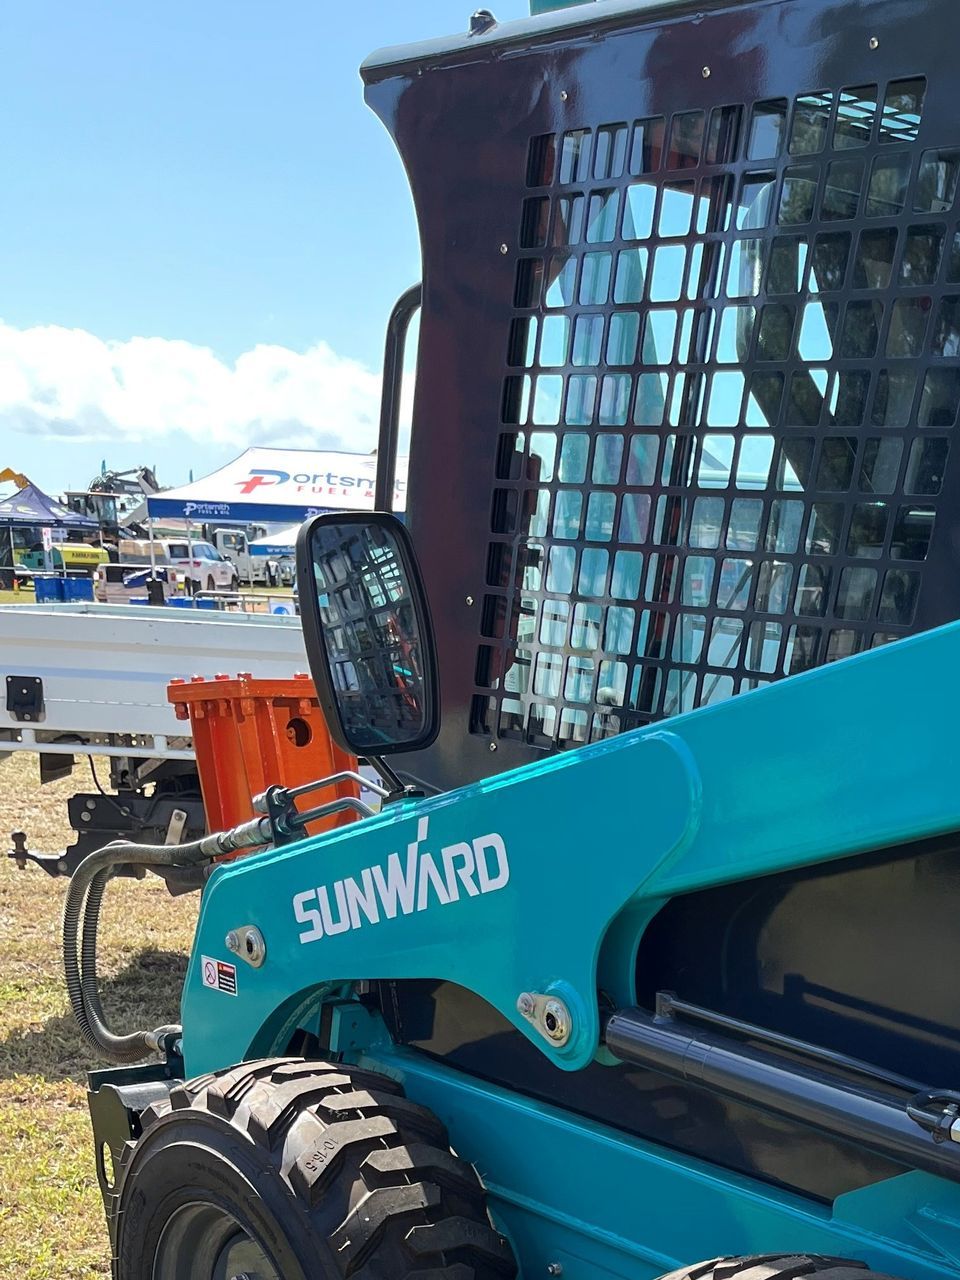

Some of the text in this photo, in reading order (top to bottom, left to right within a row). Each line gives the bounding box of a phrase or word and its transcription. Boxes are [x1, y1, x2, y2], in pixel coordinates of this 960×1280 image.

[234, 469, 406, 494] Portsmt
[297, 485, 349, 495] FUEL
[293, 816, 510, 944] SUNWARD
[305, 1138, 339, 1172] 10-16.5
